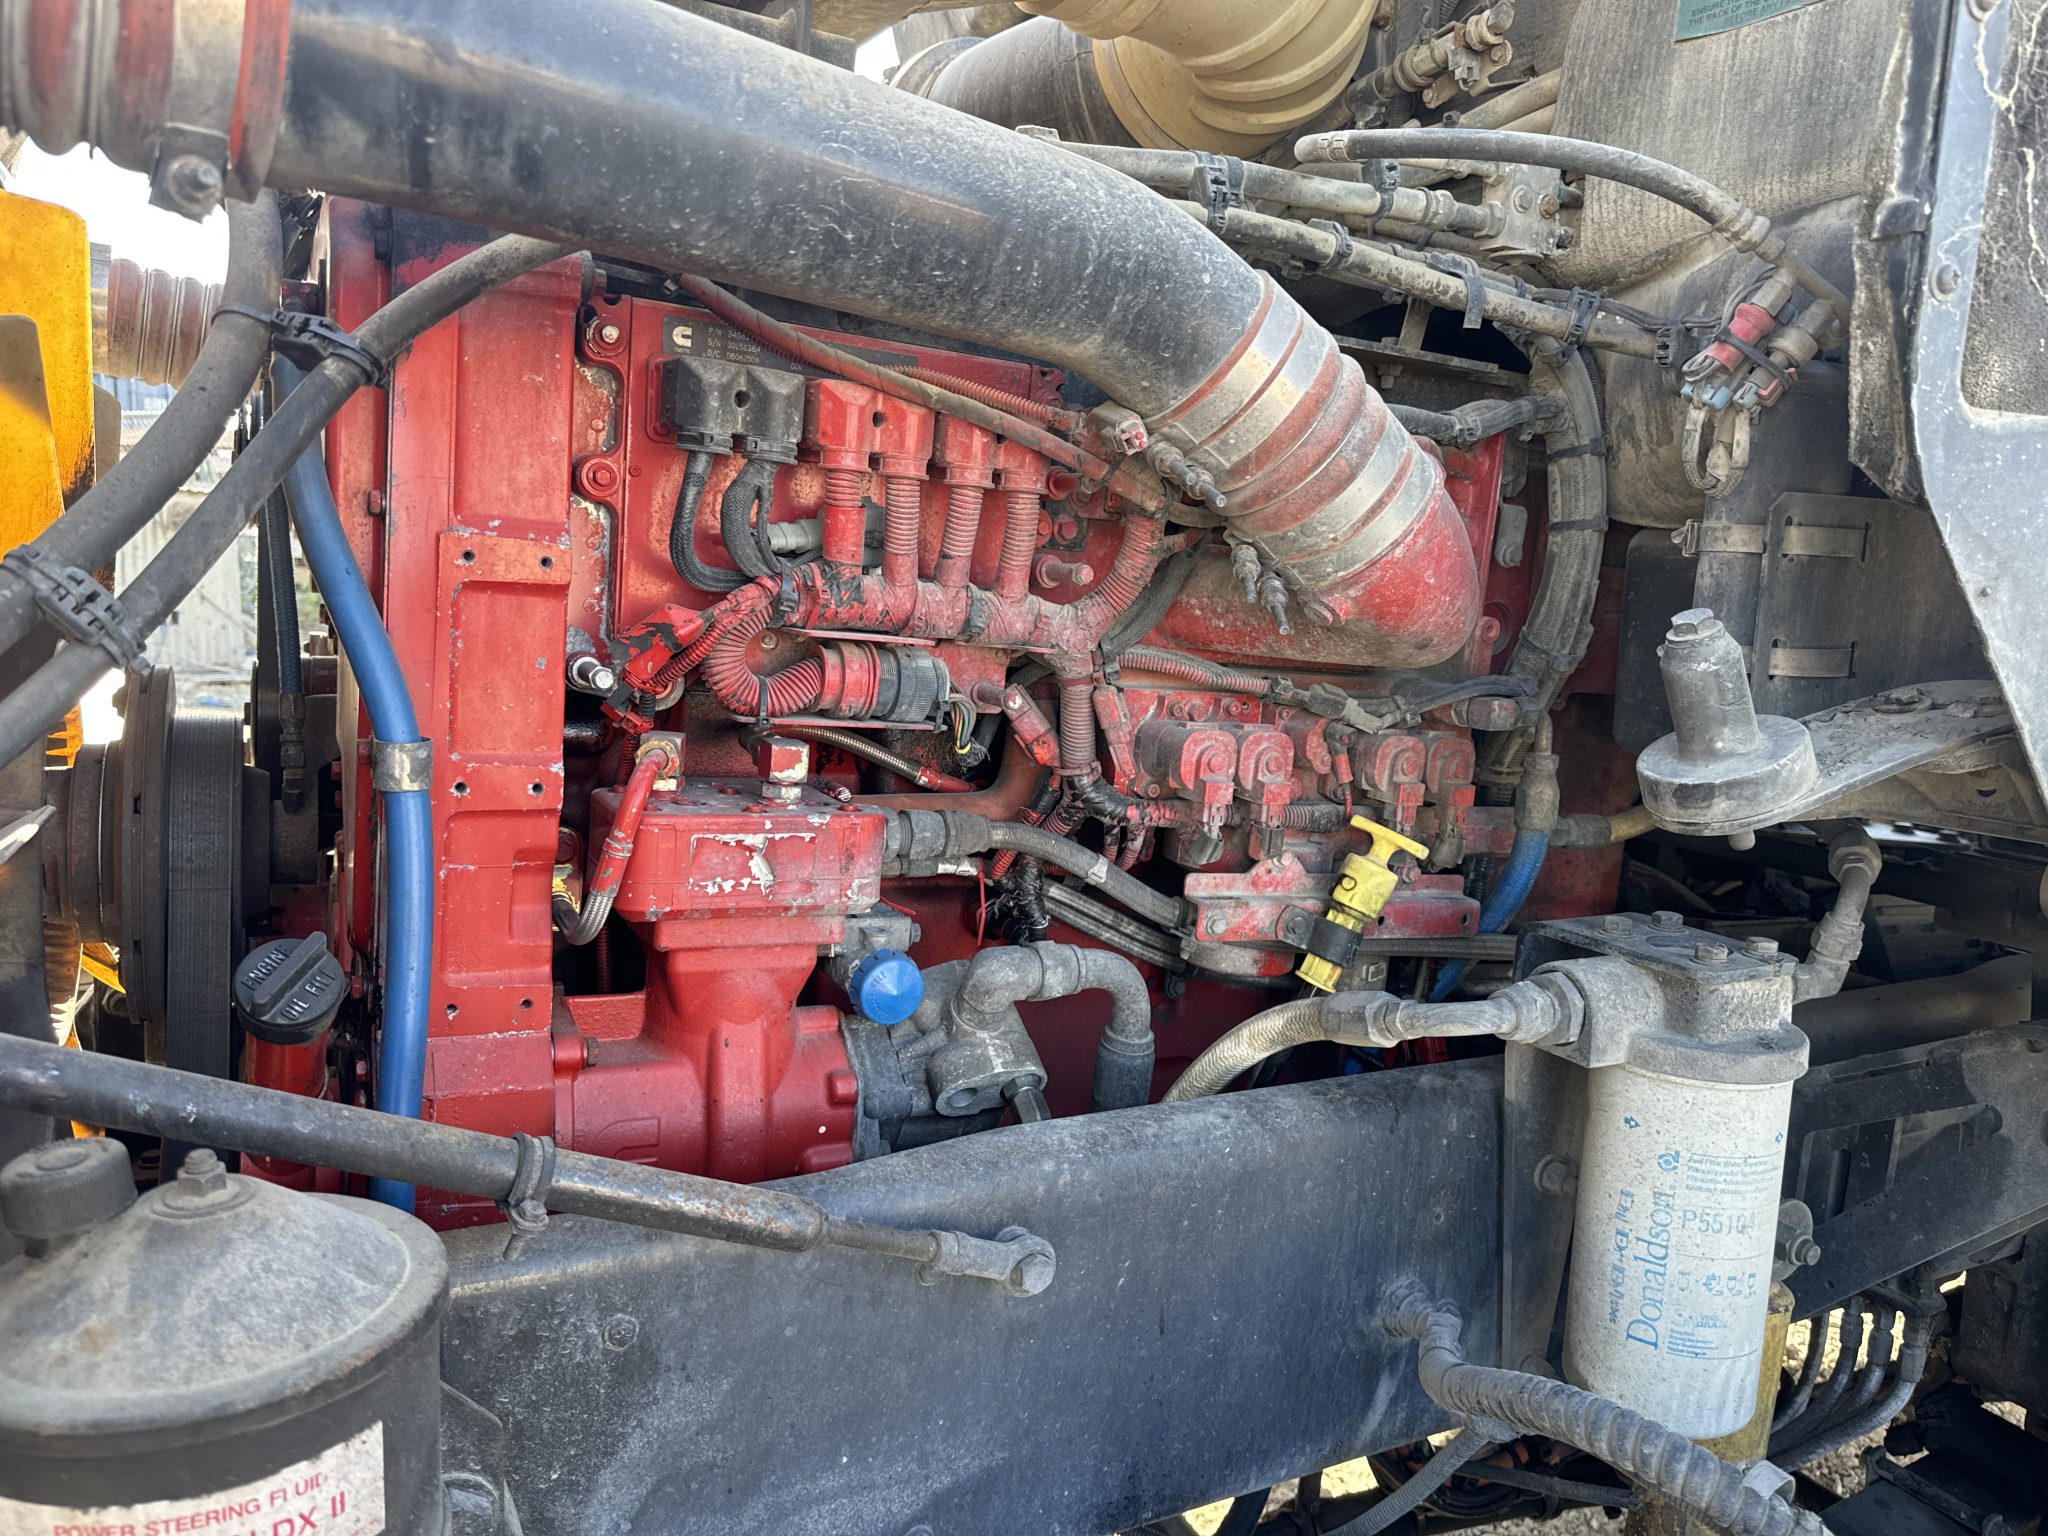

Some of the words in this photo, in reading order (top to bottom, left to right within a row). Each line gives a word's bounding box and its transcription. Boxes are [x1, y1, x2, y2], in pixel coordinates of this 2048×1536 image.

[1689, 17, 1706, 27] THE
[1706, 10, 1729, 22] BACK
[1731, 5, 1744, 15] OF
[1692, 1, 1725, 17] ENSURE
[1724, 10, 1758, 24] BEFORE
[1761, 3, 1780, 15] ANY
[708, 327, 722, 337] P/N
[707, 349, 721, 359] D/C
[241, 944, 291, 992] ENGINE
[280, 998, 311, 1020] OIL
[304, 969, 338, 998] FILL
[1626, 1190, 1676, 1350] Donaldson
[53, 1524, 136, 1536] POWER
[143, 1497, 261, 1536] STEERING
